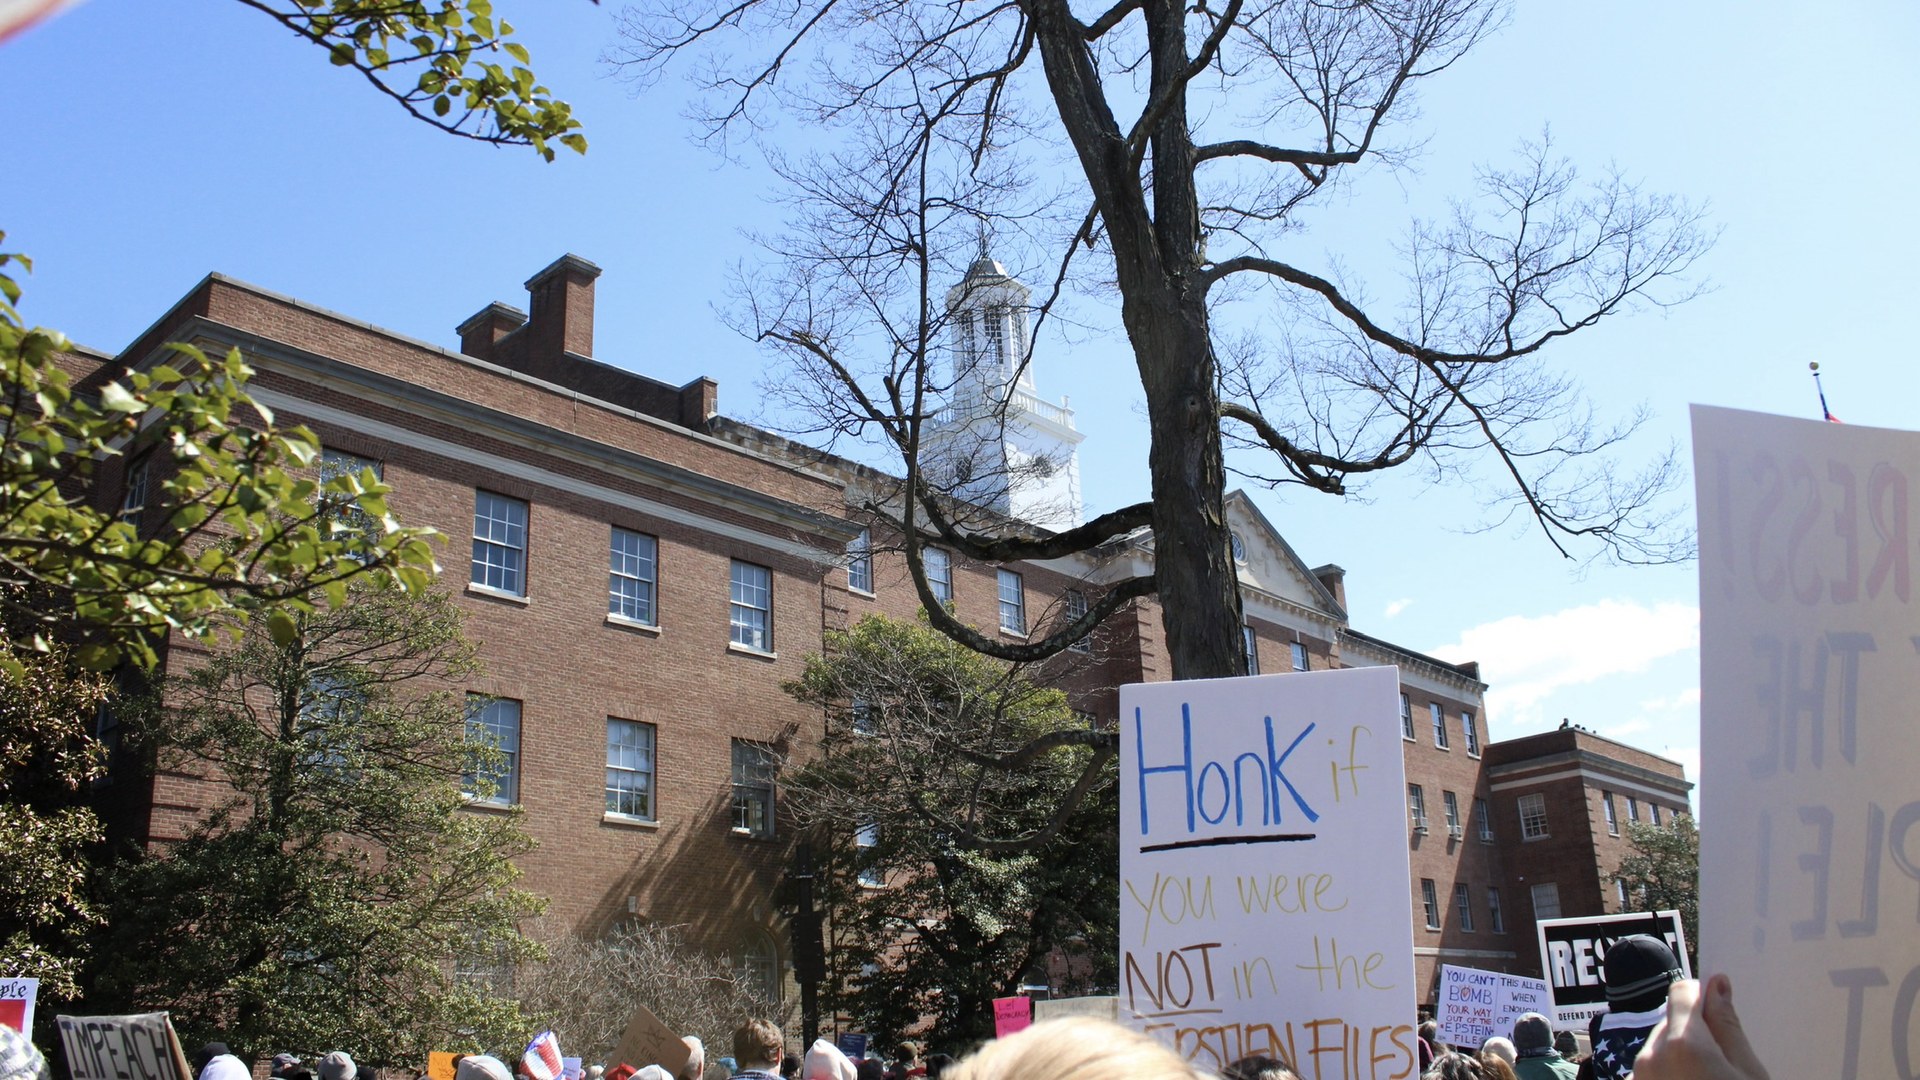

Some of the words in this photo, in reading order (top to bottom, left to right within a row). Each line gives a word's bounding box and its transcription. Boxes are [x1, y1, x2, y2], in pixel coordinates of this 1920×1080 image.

[1327, 725, 1372, 802] if
[1237, 873, 1348, 913] were
[1125, 943, 1222, 1011] NOT
[1232, 943, 1277, 1000] in
[1296, 935, 1396, 992] the
[1446, 969, 1466, 983] YOU
[1468, 974, 1496, 986] CAN'T
[1500, 977, 1520, 988] THIS
[1521, 981, 1535, 990] ALL
[1535, 983, 1547, 992] EN
[1449, 985, 1493, 1006] BOMB
[1511, 992, 1537, 1004] WHEN
[1446, 1003, 1470, 1015] YOUR
[1473, 1007, 1492, 1018] WAY
[1558, 1011, 1585, 1021] DEFEND
[1496, 1016, 1510, 1025] OF
[1444, 1022, 1492, 1036] EPSTEIN
[1144, 1021, 1297, 1074] PSTIEN
[1454, 1034, 1481, 1045] FILE
[60, 1020, 177, 1080] IMPEACH
